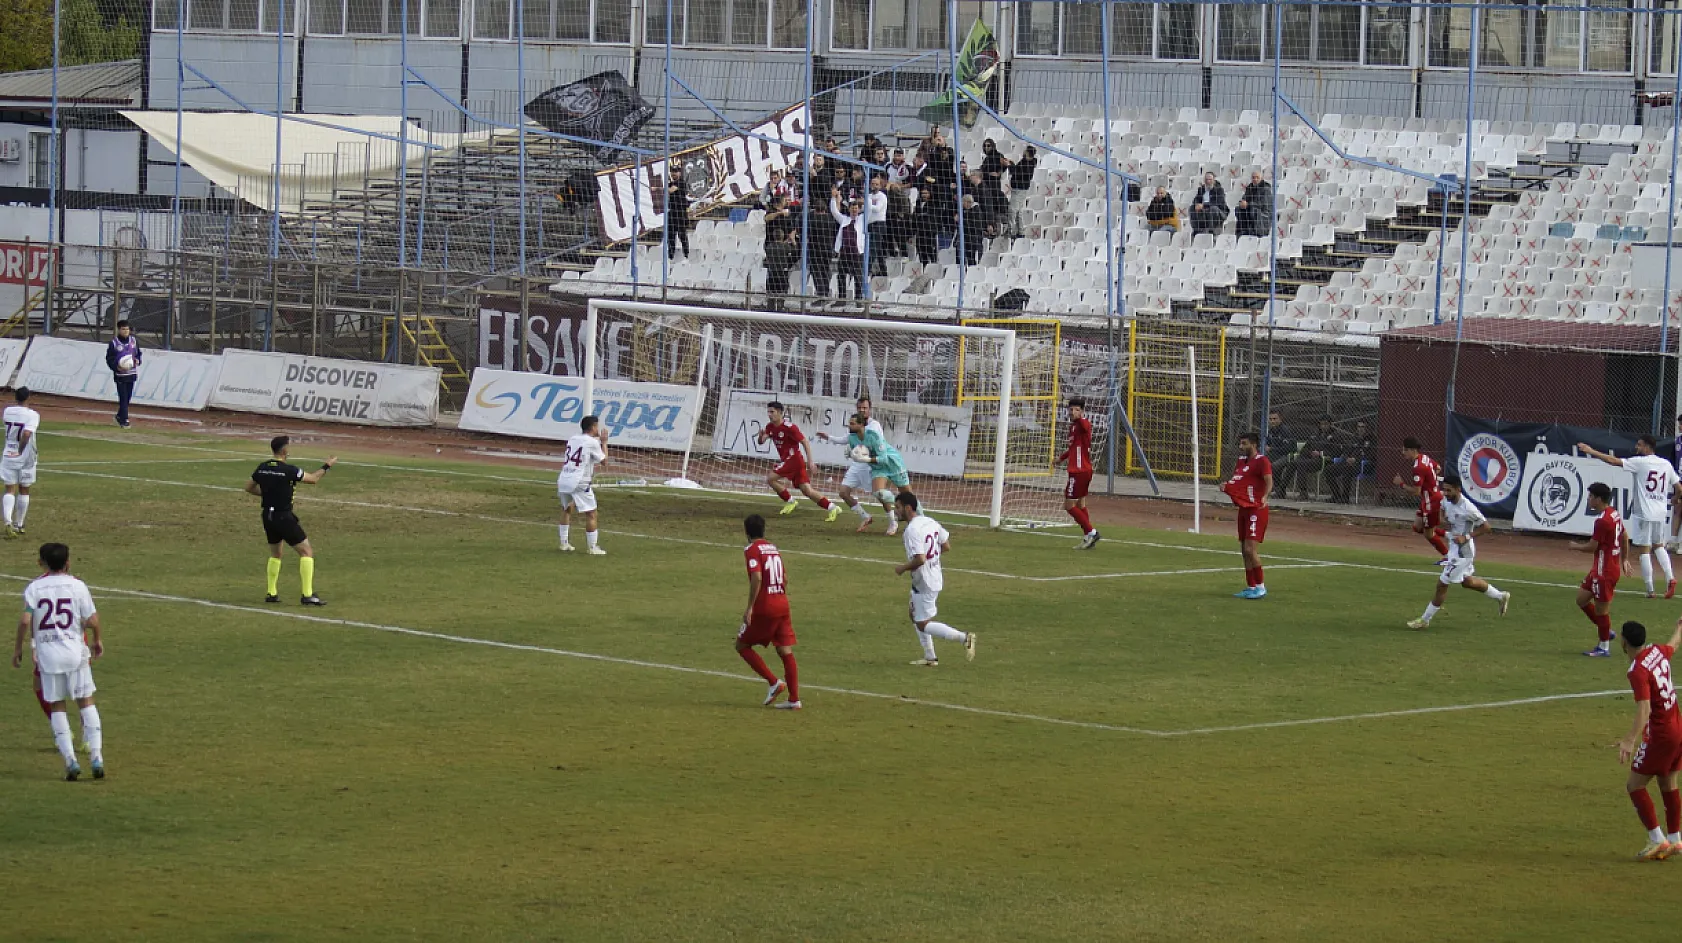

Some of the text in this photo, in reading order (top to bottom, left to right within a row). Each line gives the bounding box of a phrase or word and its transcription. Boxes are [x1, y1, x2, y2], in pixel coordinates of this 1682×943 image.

[285, 359, 378, 391] DİSCOVER
[278, 388, 371, 419] ÖLÜDENİZ
[531, 382, 682, 438] Tempa
[783, 407, 959, 439] ARSLNLAR
[564, 444, 583, 467] 34
[1645, 470, 1667, 493] 51
[764, 554, 783, 585] 10
[36, 597, 74, 631] 25
